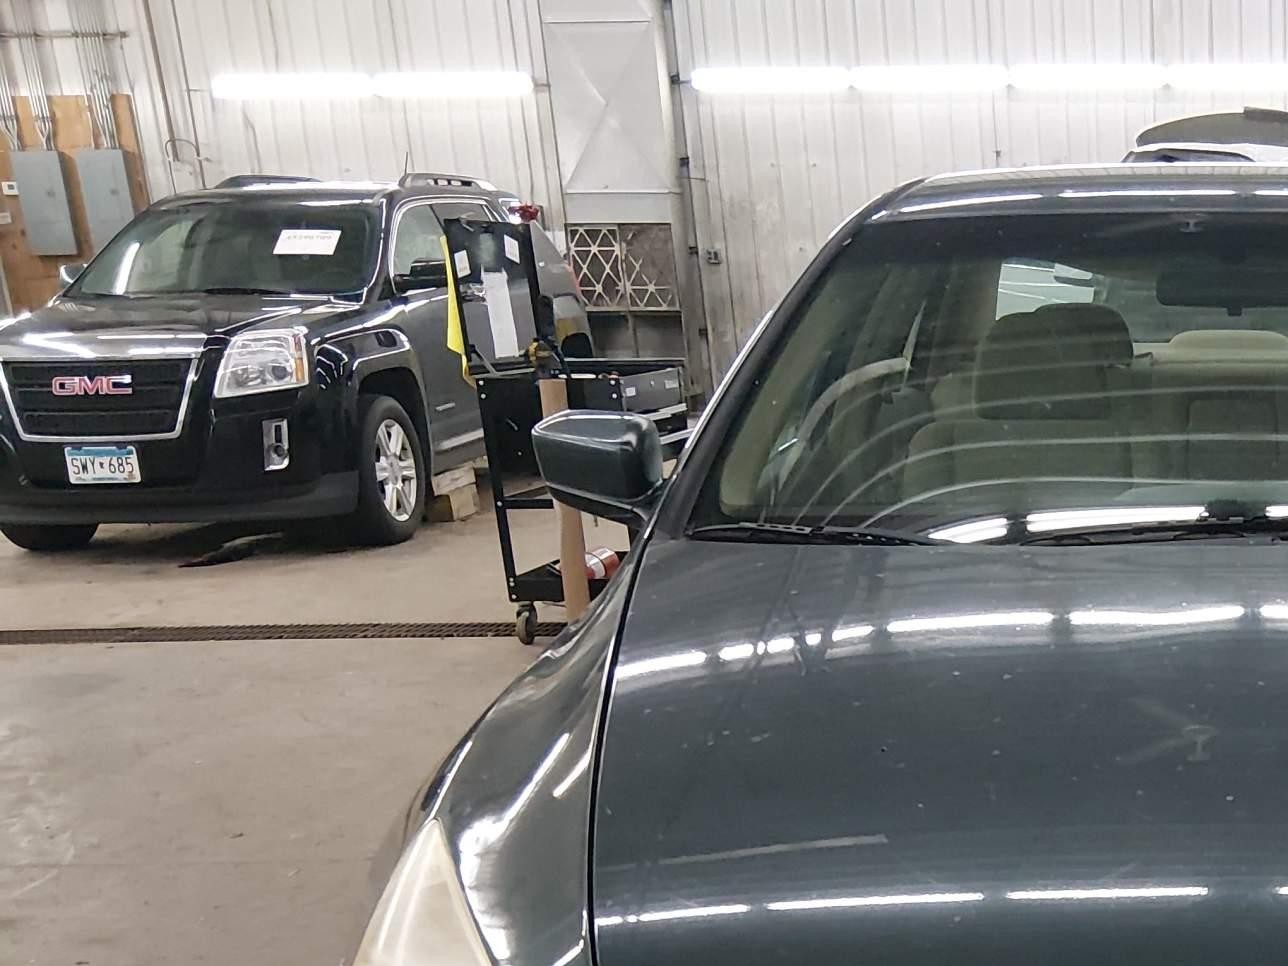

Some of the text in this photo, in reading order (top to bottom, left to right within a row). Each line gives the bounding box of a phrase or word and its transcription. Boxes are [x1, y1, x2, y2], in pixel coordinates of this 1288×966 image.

[52, 374, 133, 396] GMC
[71, 456, 134, 476] SWY 685
